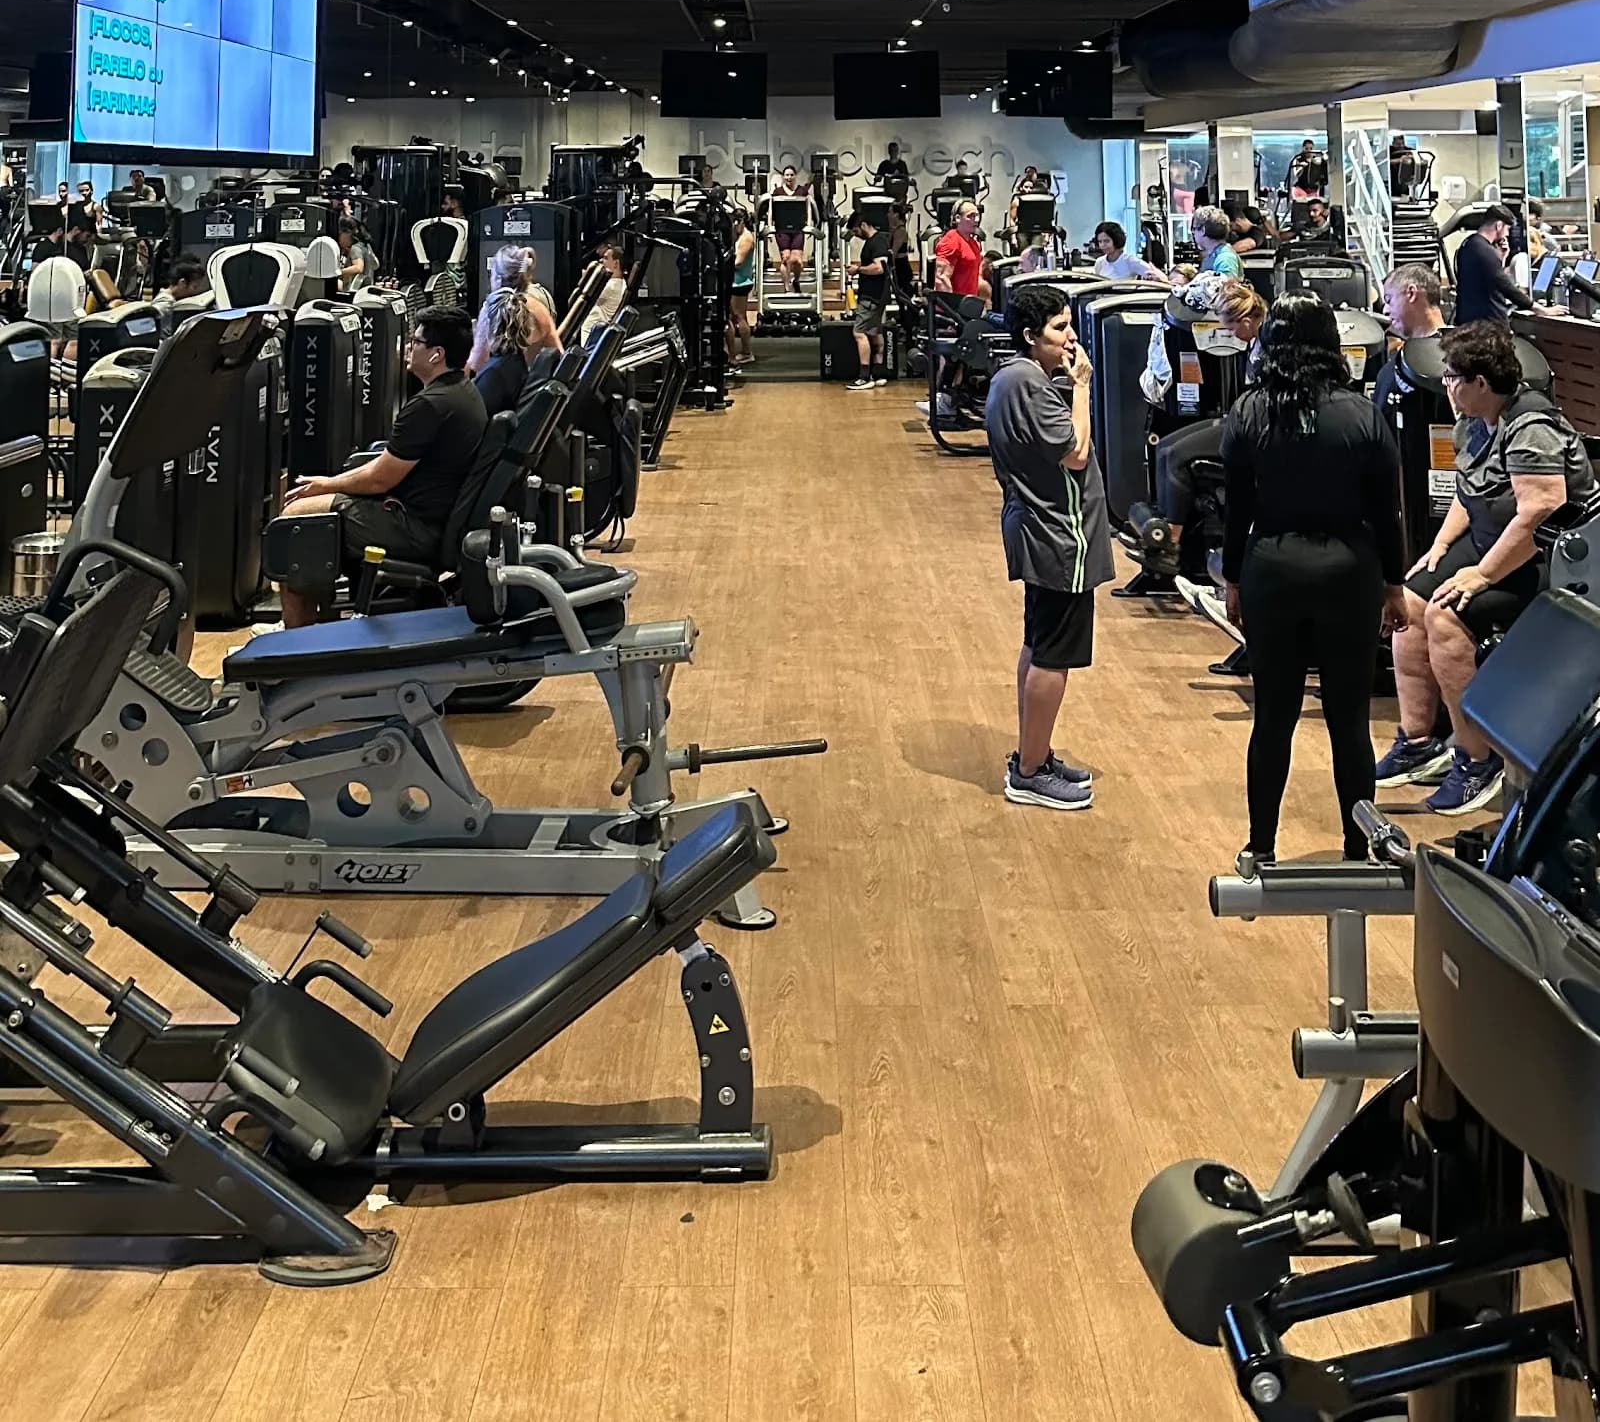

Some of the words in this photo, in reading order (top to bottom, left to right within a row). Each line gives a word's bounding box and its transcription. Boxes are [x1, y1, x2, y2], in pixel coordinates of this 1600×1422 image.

[304, 335, 318, 437] MATRIX
[362, 316, 375, 406] MATRIX
[338, 863, 422, 880] HOIST
